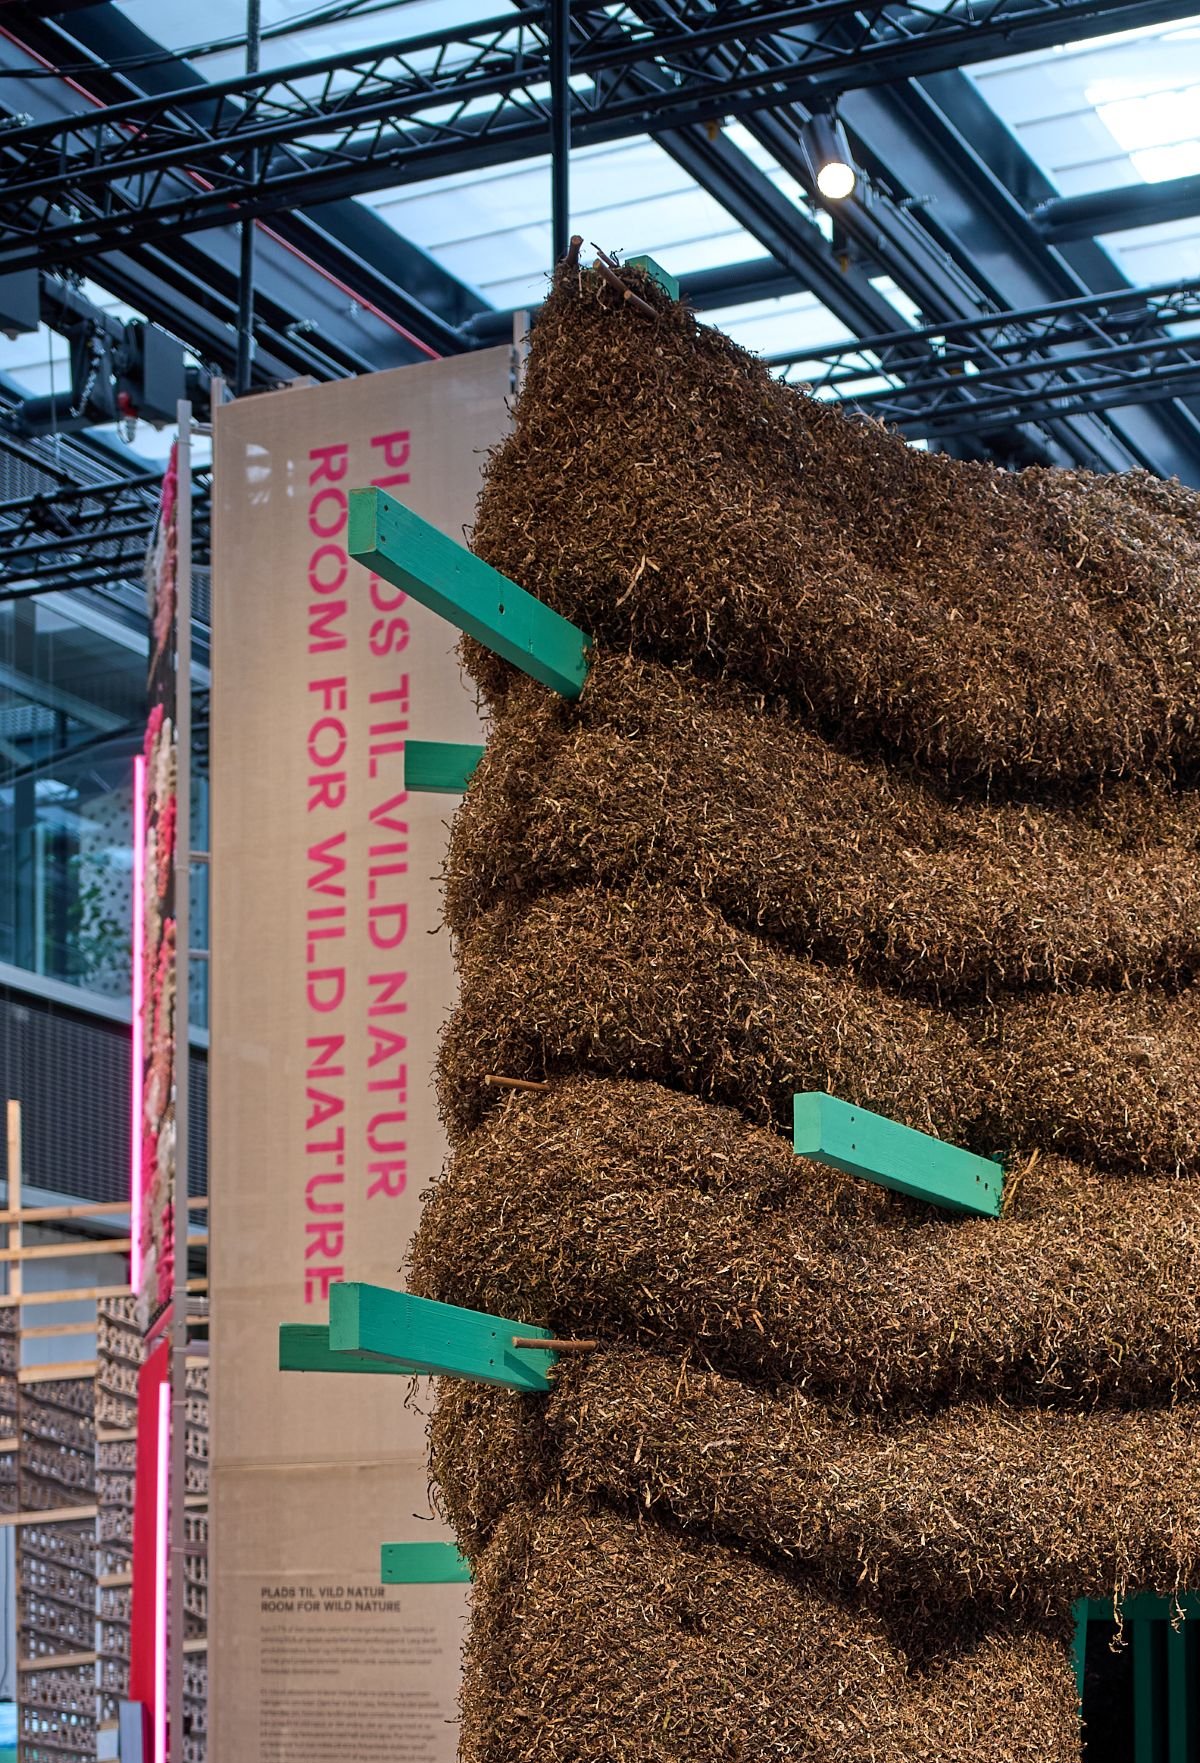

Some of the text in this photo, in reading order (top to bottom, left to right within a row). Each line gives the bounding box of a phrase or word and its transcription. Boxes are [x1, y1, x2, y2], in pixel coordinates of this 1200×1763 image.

[304, 444, 349, 1304] ROOM FOR WILD NATURE
[366, 429, 411, 1200] PLDS TIL VILD NATUR
[261, 1586, 385, 1598] PLADS TIL VILD NATUR
[261, 1600, 401, 1613] ROOM FOR WILD NATURE
